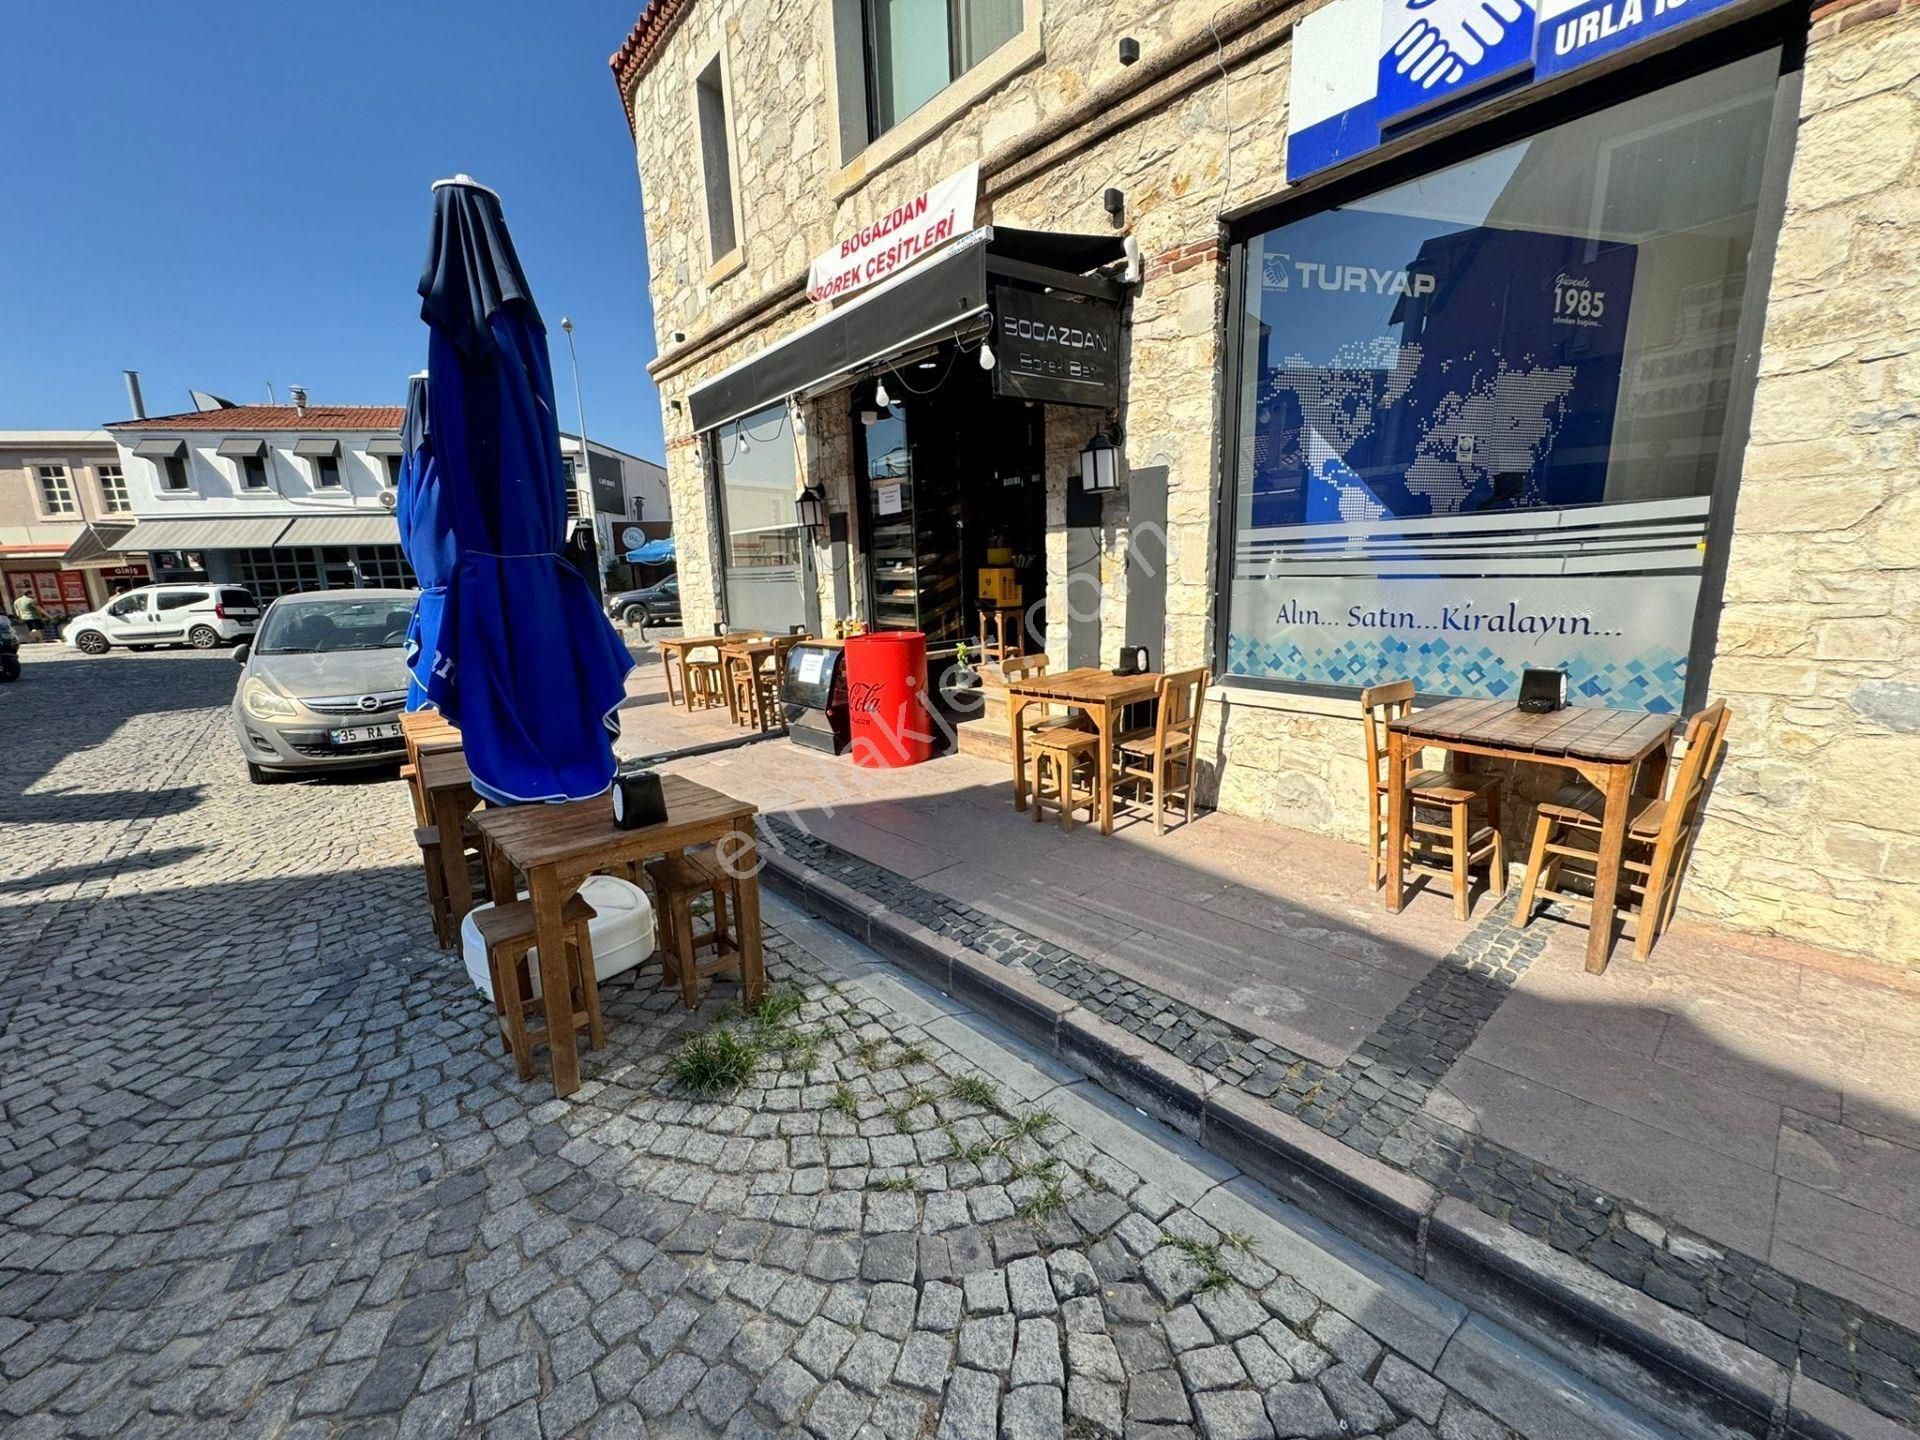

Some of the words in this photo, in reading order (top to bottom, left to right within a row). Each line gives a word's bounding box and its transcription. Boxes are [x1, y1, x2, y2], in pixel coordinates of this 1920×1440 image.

[1555, 0, 1643, 56] URLA
[816, 264, 861, 301] BÖREK
[865, 208, 956, 282] ÇEŞİTLERİ
[1294, 261, 1436, 298] TURYAP
[1553, 287, 1606, 318] 1985
[340, 728, 357, 742] 35
[366, 726, 384, 739] RA
